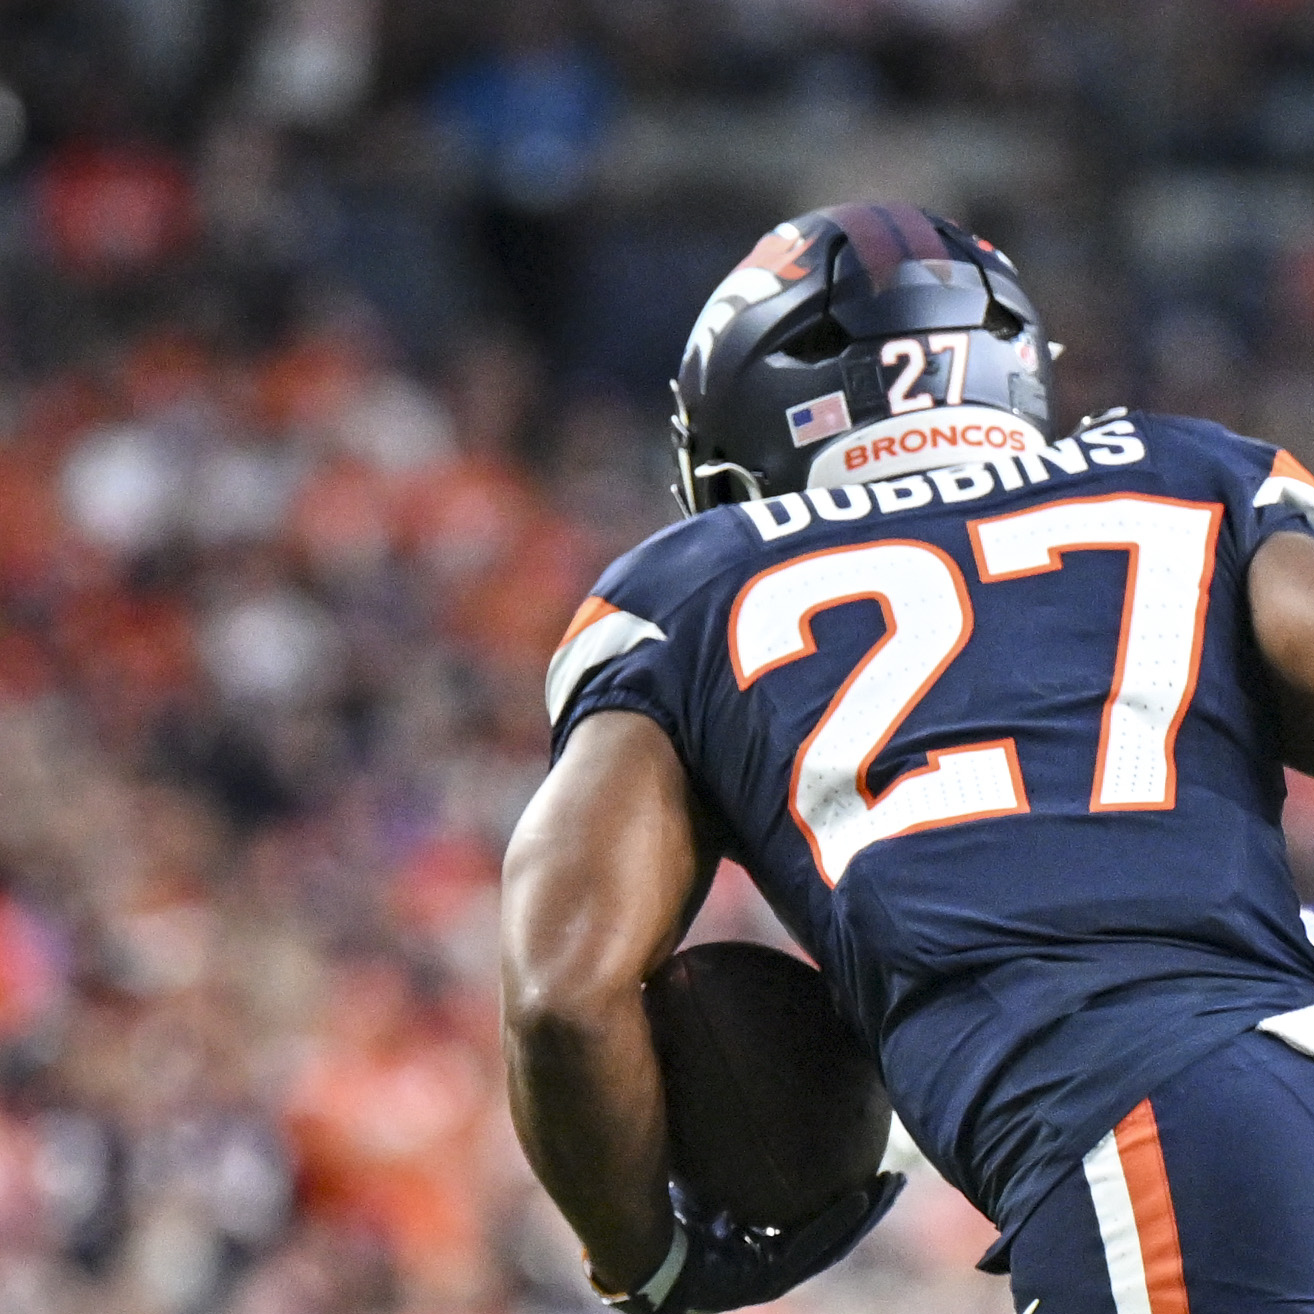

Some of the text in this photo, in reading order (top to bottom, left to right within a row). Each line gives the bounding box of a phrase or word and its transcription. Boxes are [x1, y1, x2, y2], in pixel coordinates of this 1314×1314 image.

[879, 333, 970, 416] 27
[843, 425, 1027, 471] BRONCOS
[728, 491, 1225, 890] 27
